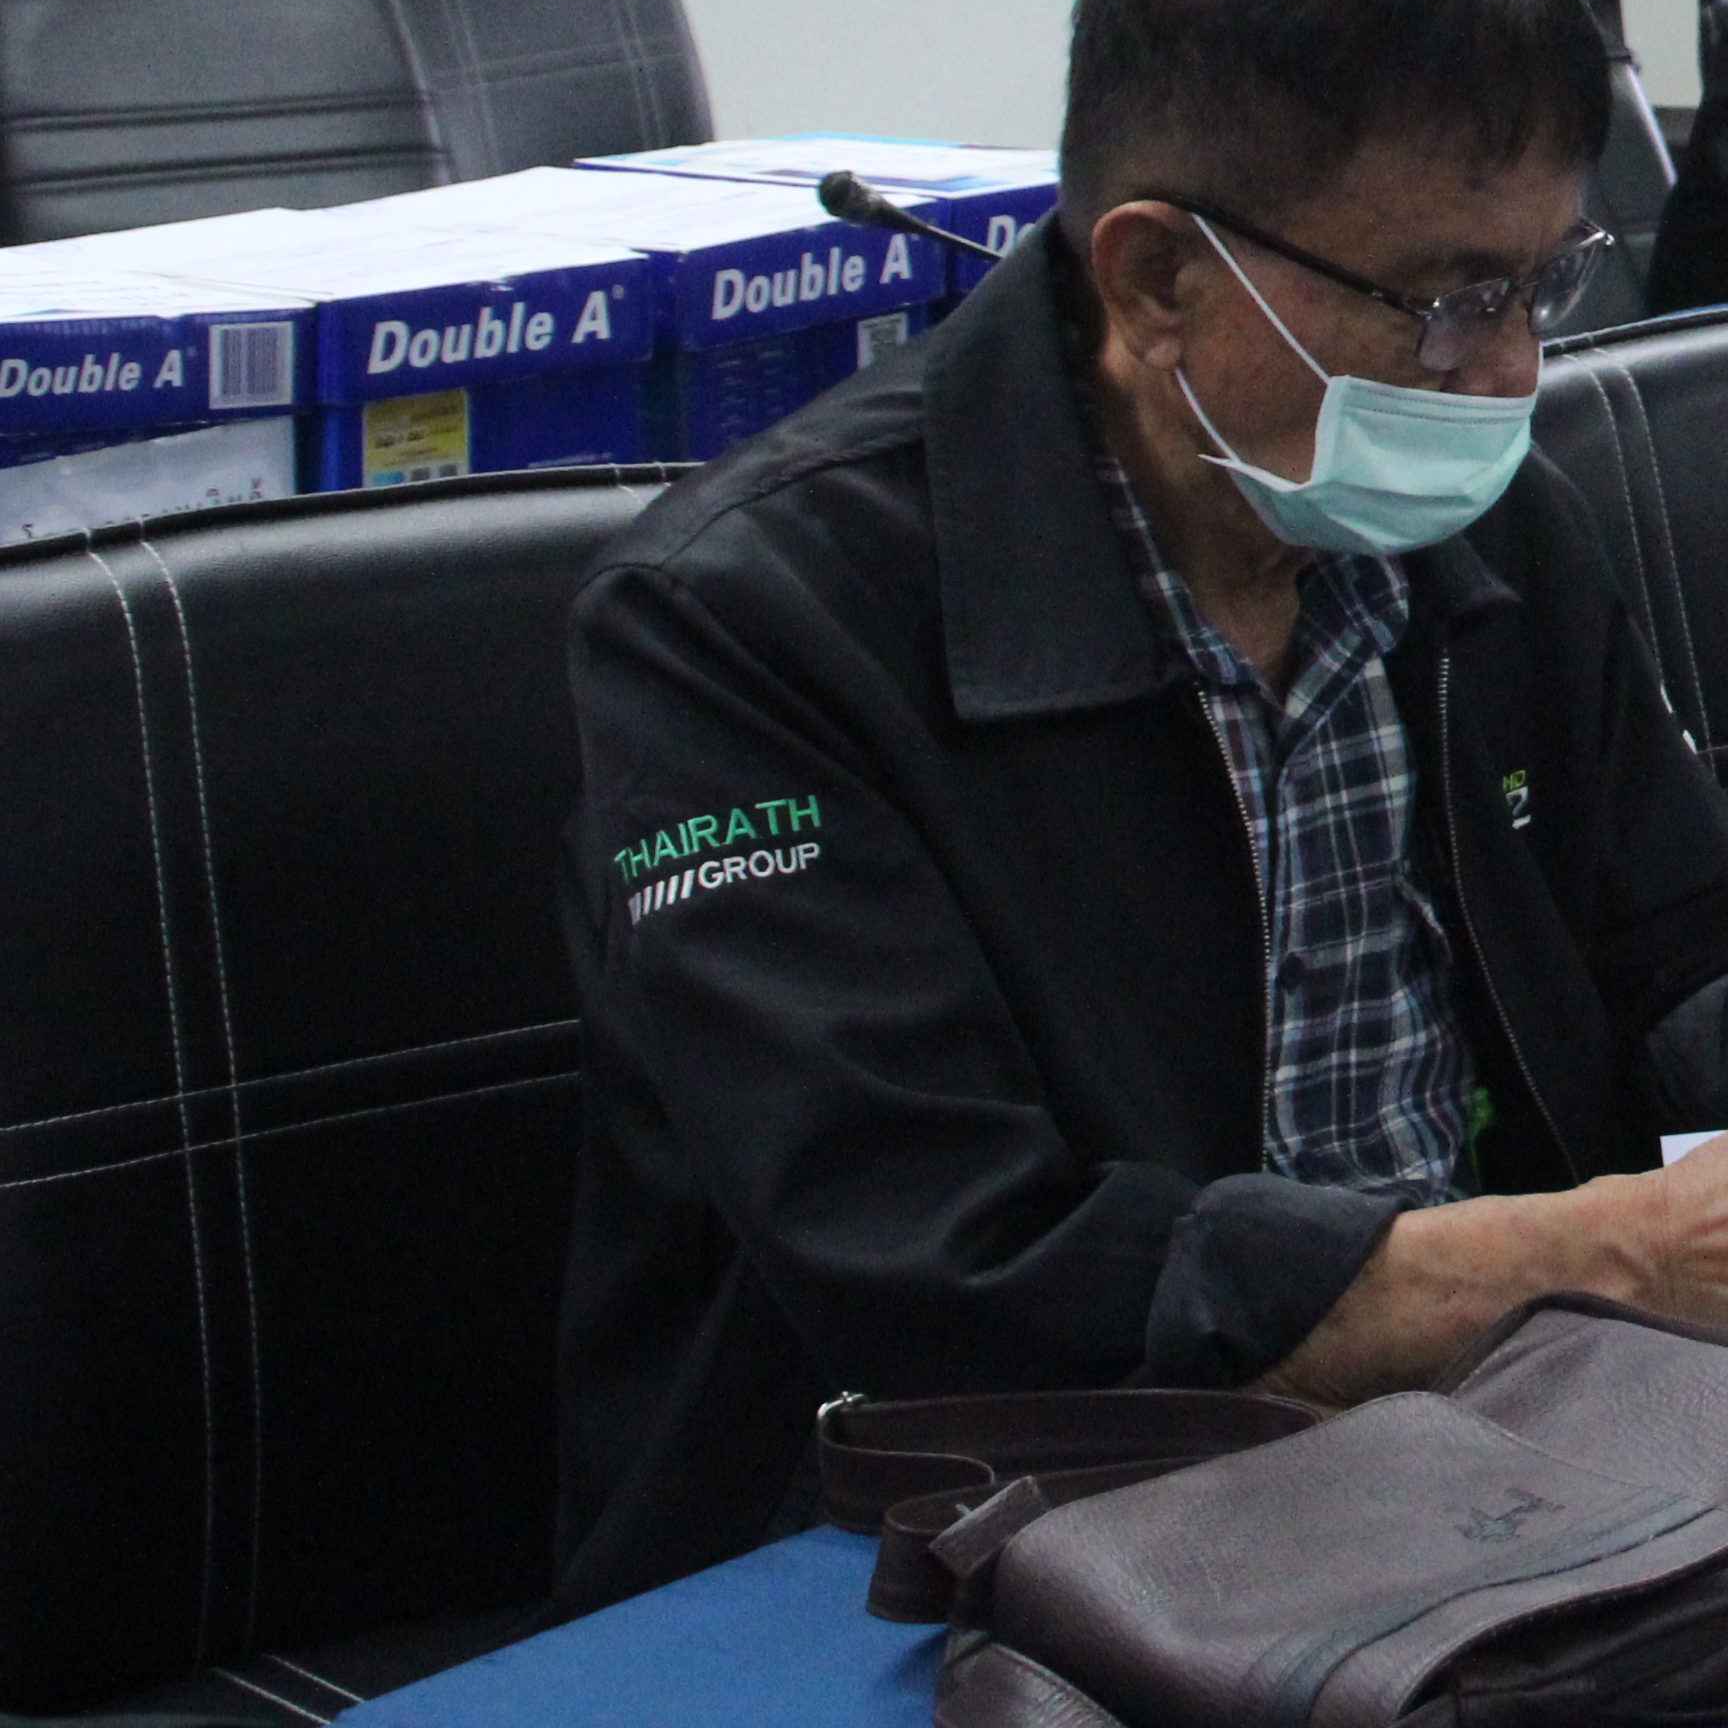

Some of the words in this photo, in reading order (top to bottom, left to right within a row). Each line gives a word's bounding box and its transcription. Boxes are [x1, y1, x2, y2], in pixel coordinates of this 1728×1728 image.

[712, 247, 866, 320] Double
[879, 233, 913, 284] A
[0, 352, 142, 398] Double
[153, 349, 185, 389] A
[367, 302, 555, 375] Double
[571, 290, 613, 344] A
[613, 795, 822, 884] THAIRATH
[698, 842, 821, 890] GROUP
